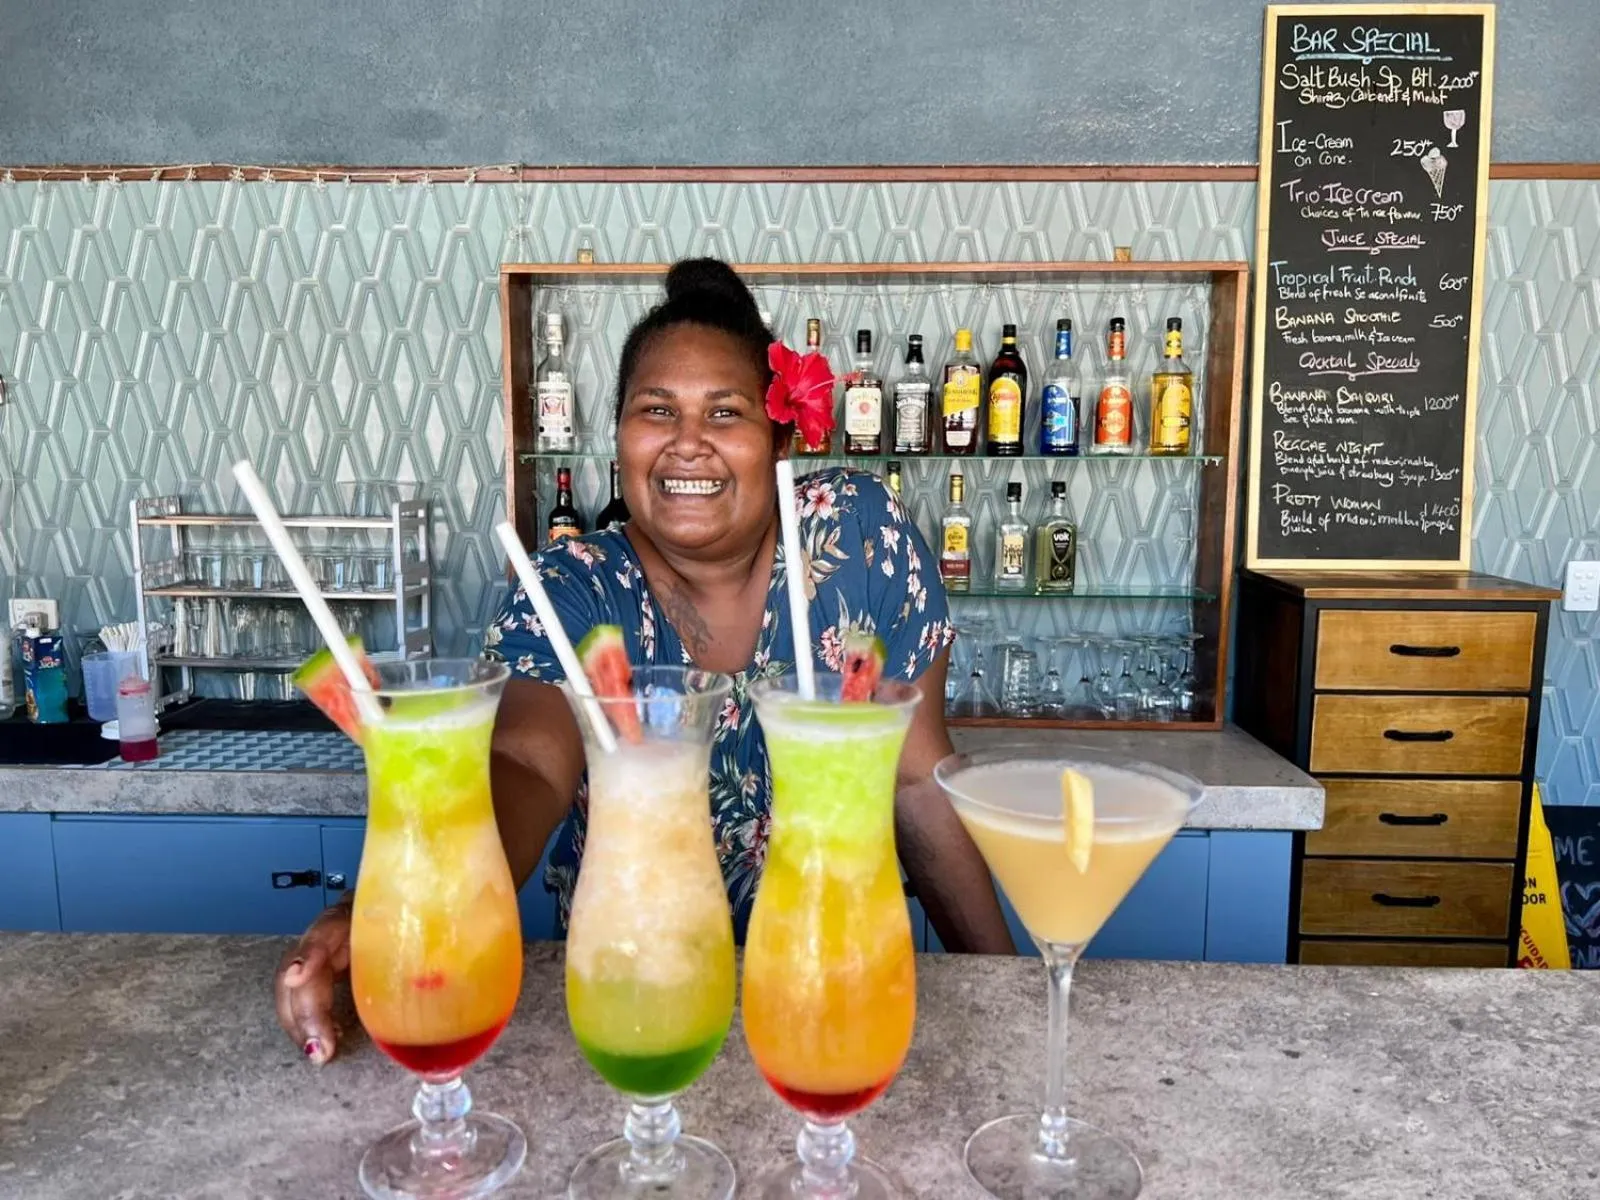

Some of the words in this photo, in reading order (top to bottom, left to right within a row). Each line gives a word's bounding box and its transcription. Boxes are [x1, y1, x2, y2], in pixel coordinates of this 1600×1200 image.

[1290, 24, 1337, 52] BAR
[1343, 27, 1440, 53] SPECIAL
[1280, 63, 1325, 89] Salt
[1342, 206, 1356, 221] of
[1321, 229, 1366, 246] JUICE
[1375, 232, 1426, 245] SPECIAL
[1270, 261, 1334, 287] Tropical
[1378, 264, 1417, 287] Punch
[1308, 288, 1322, 302] of
[1299, 350, 1357, 369] Cocktail
[1354, 453, 1369, 468] of
[1281, 510, 1312, 527] Build
[1318, 512, 1331, 532] of
